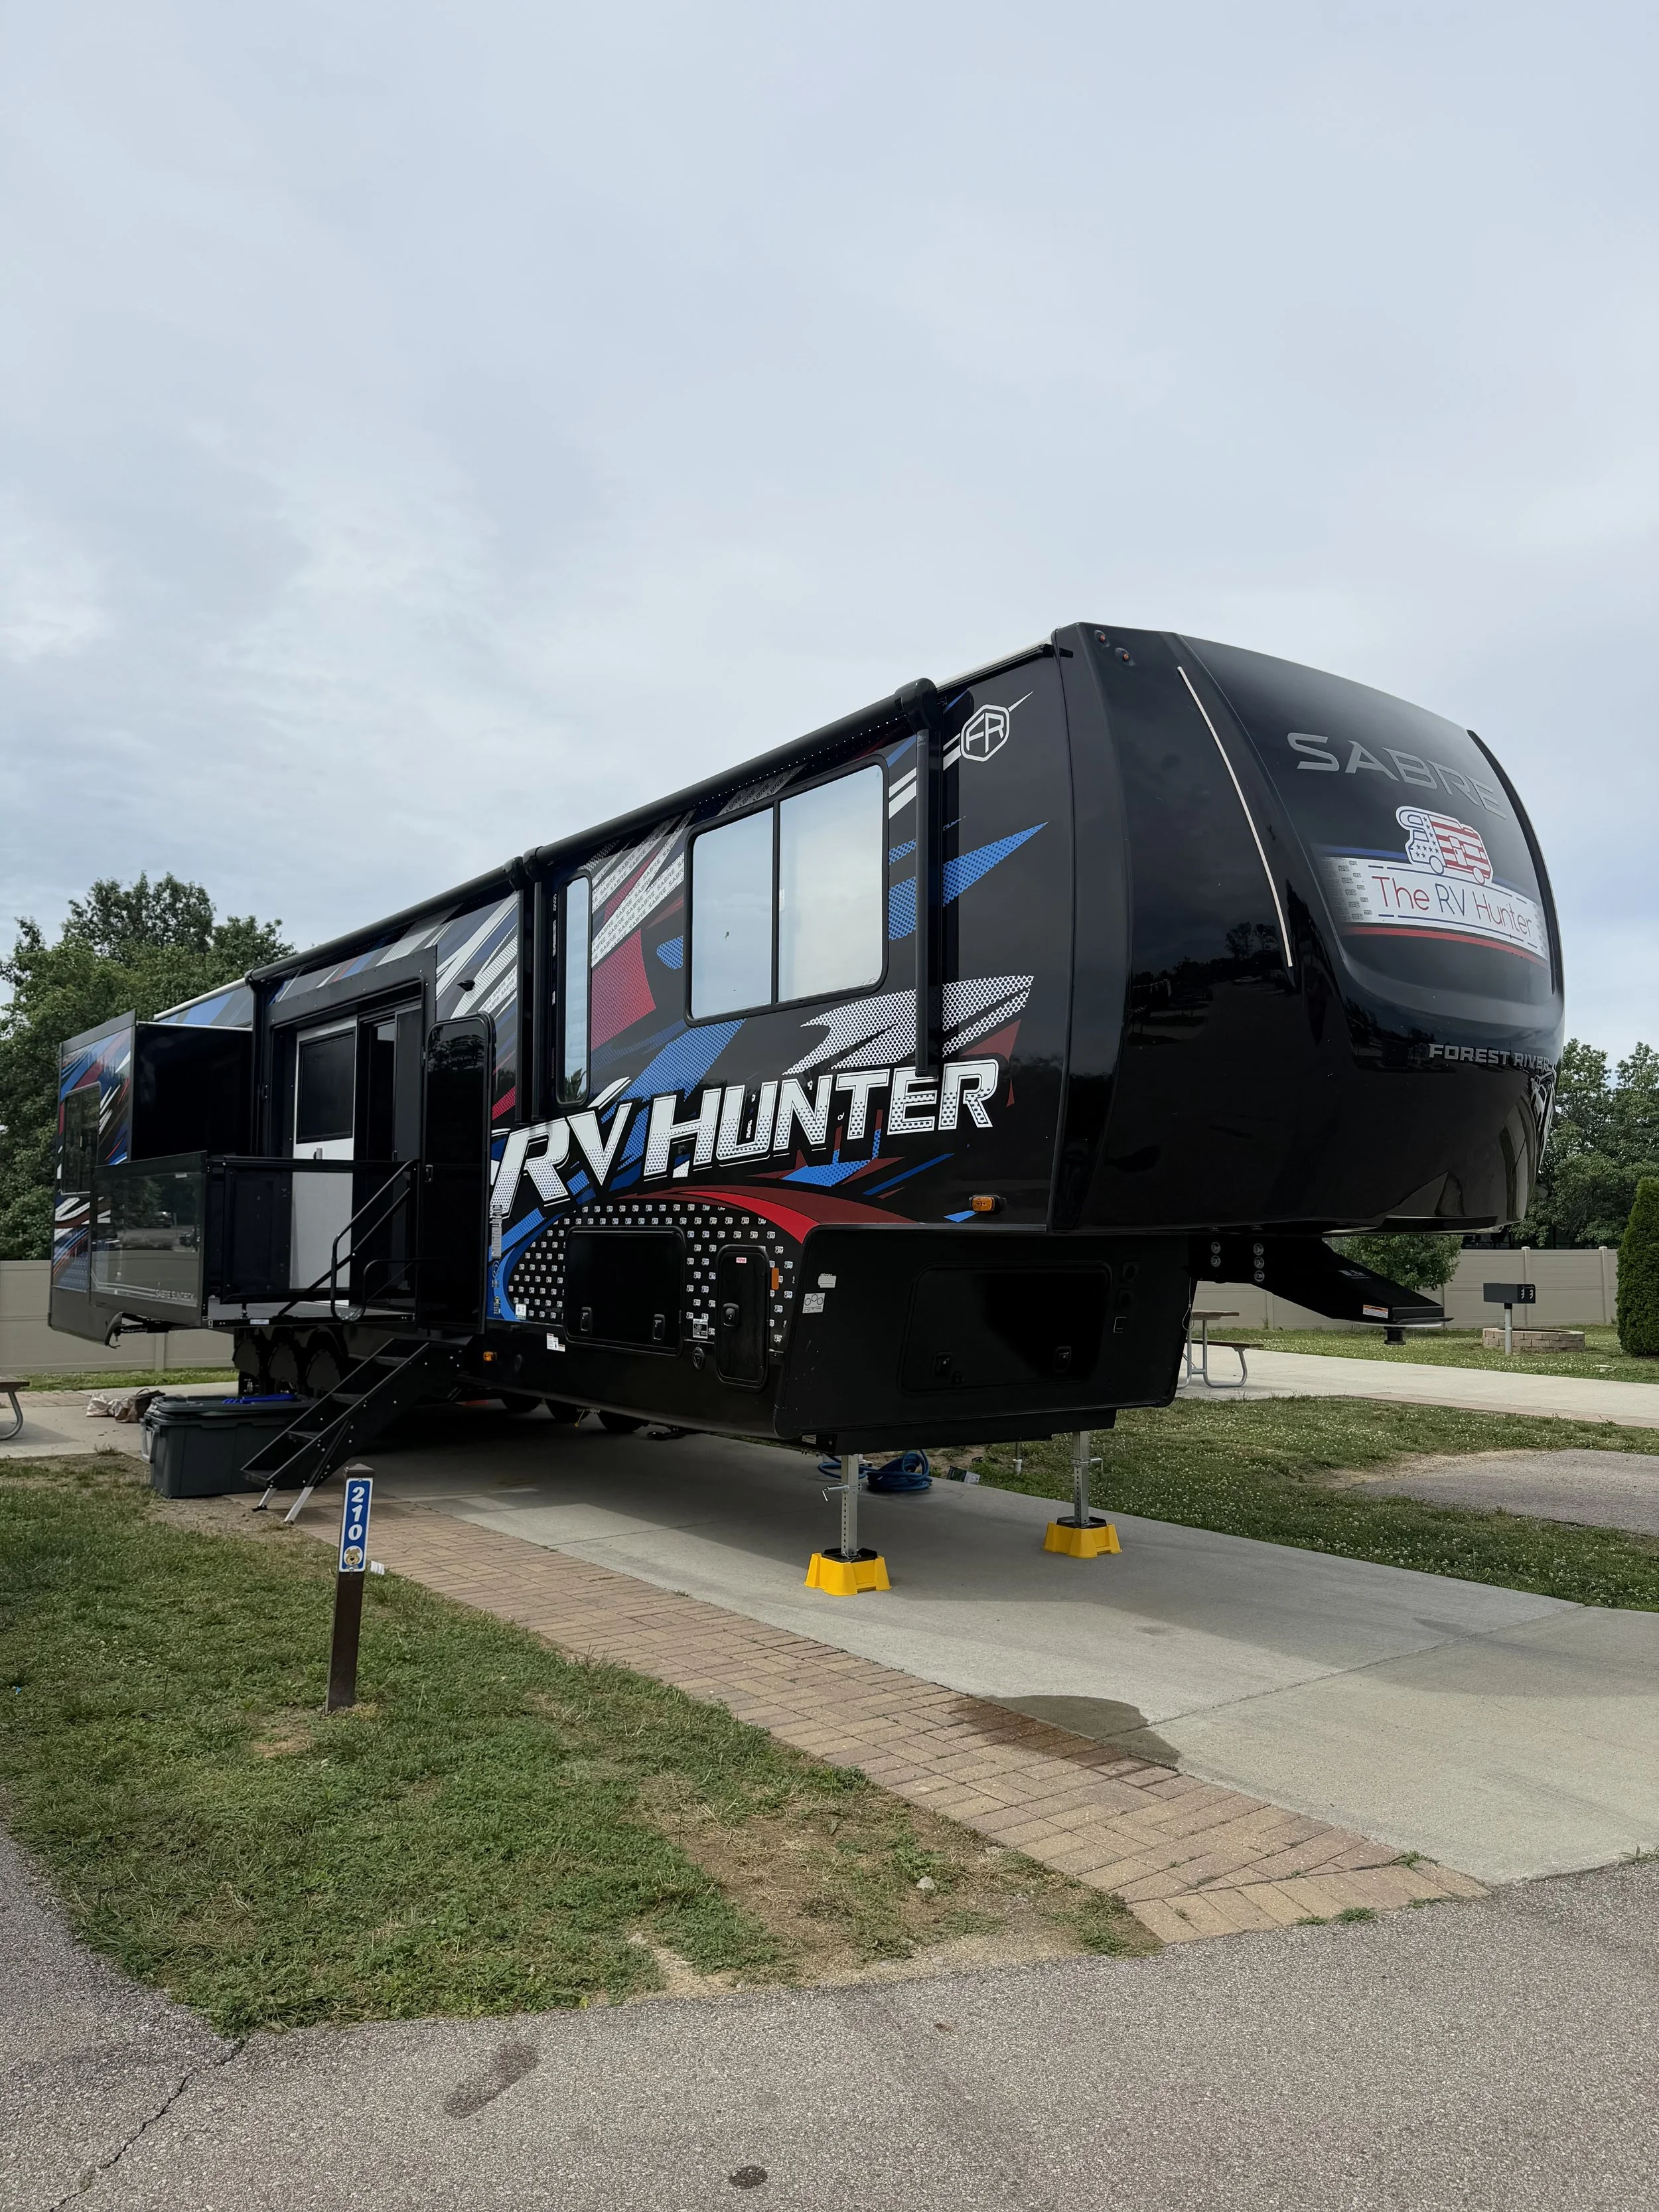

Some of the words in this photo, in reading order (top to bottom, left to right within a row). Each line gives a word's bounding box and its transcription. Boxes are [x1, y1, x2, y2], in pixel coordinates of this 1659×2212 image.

[1287, 731, 1507, 820] SABRE
[1371, 875, 1430, 911] The
[1435, 883, 1465, 916] RV
[1472, 891, 1532, 937] Hunter
[1428, 1043, 1510, 1065] FOREST
[1513, 1052, 1550, 1071] RIVER
[490, 1102, 632, 1215] RV
[643, 1059, 999, 1177] HUNTER
[348, 1486, 366, 1541] 210
